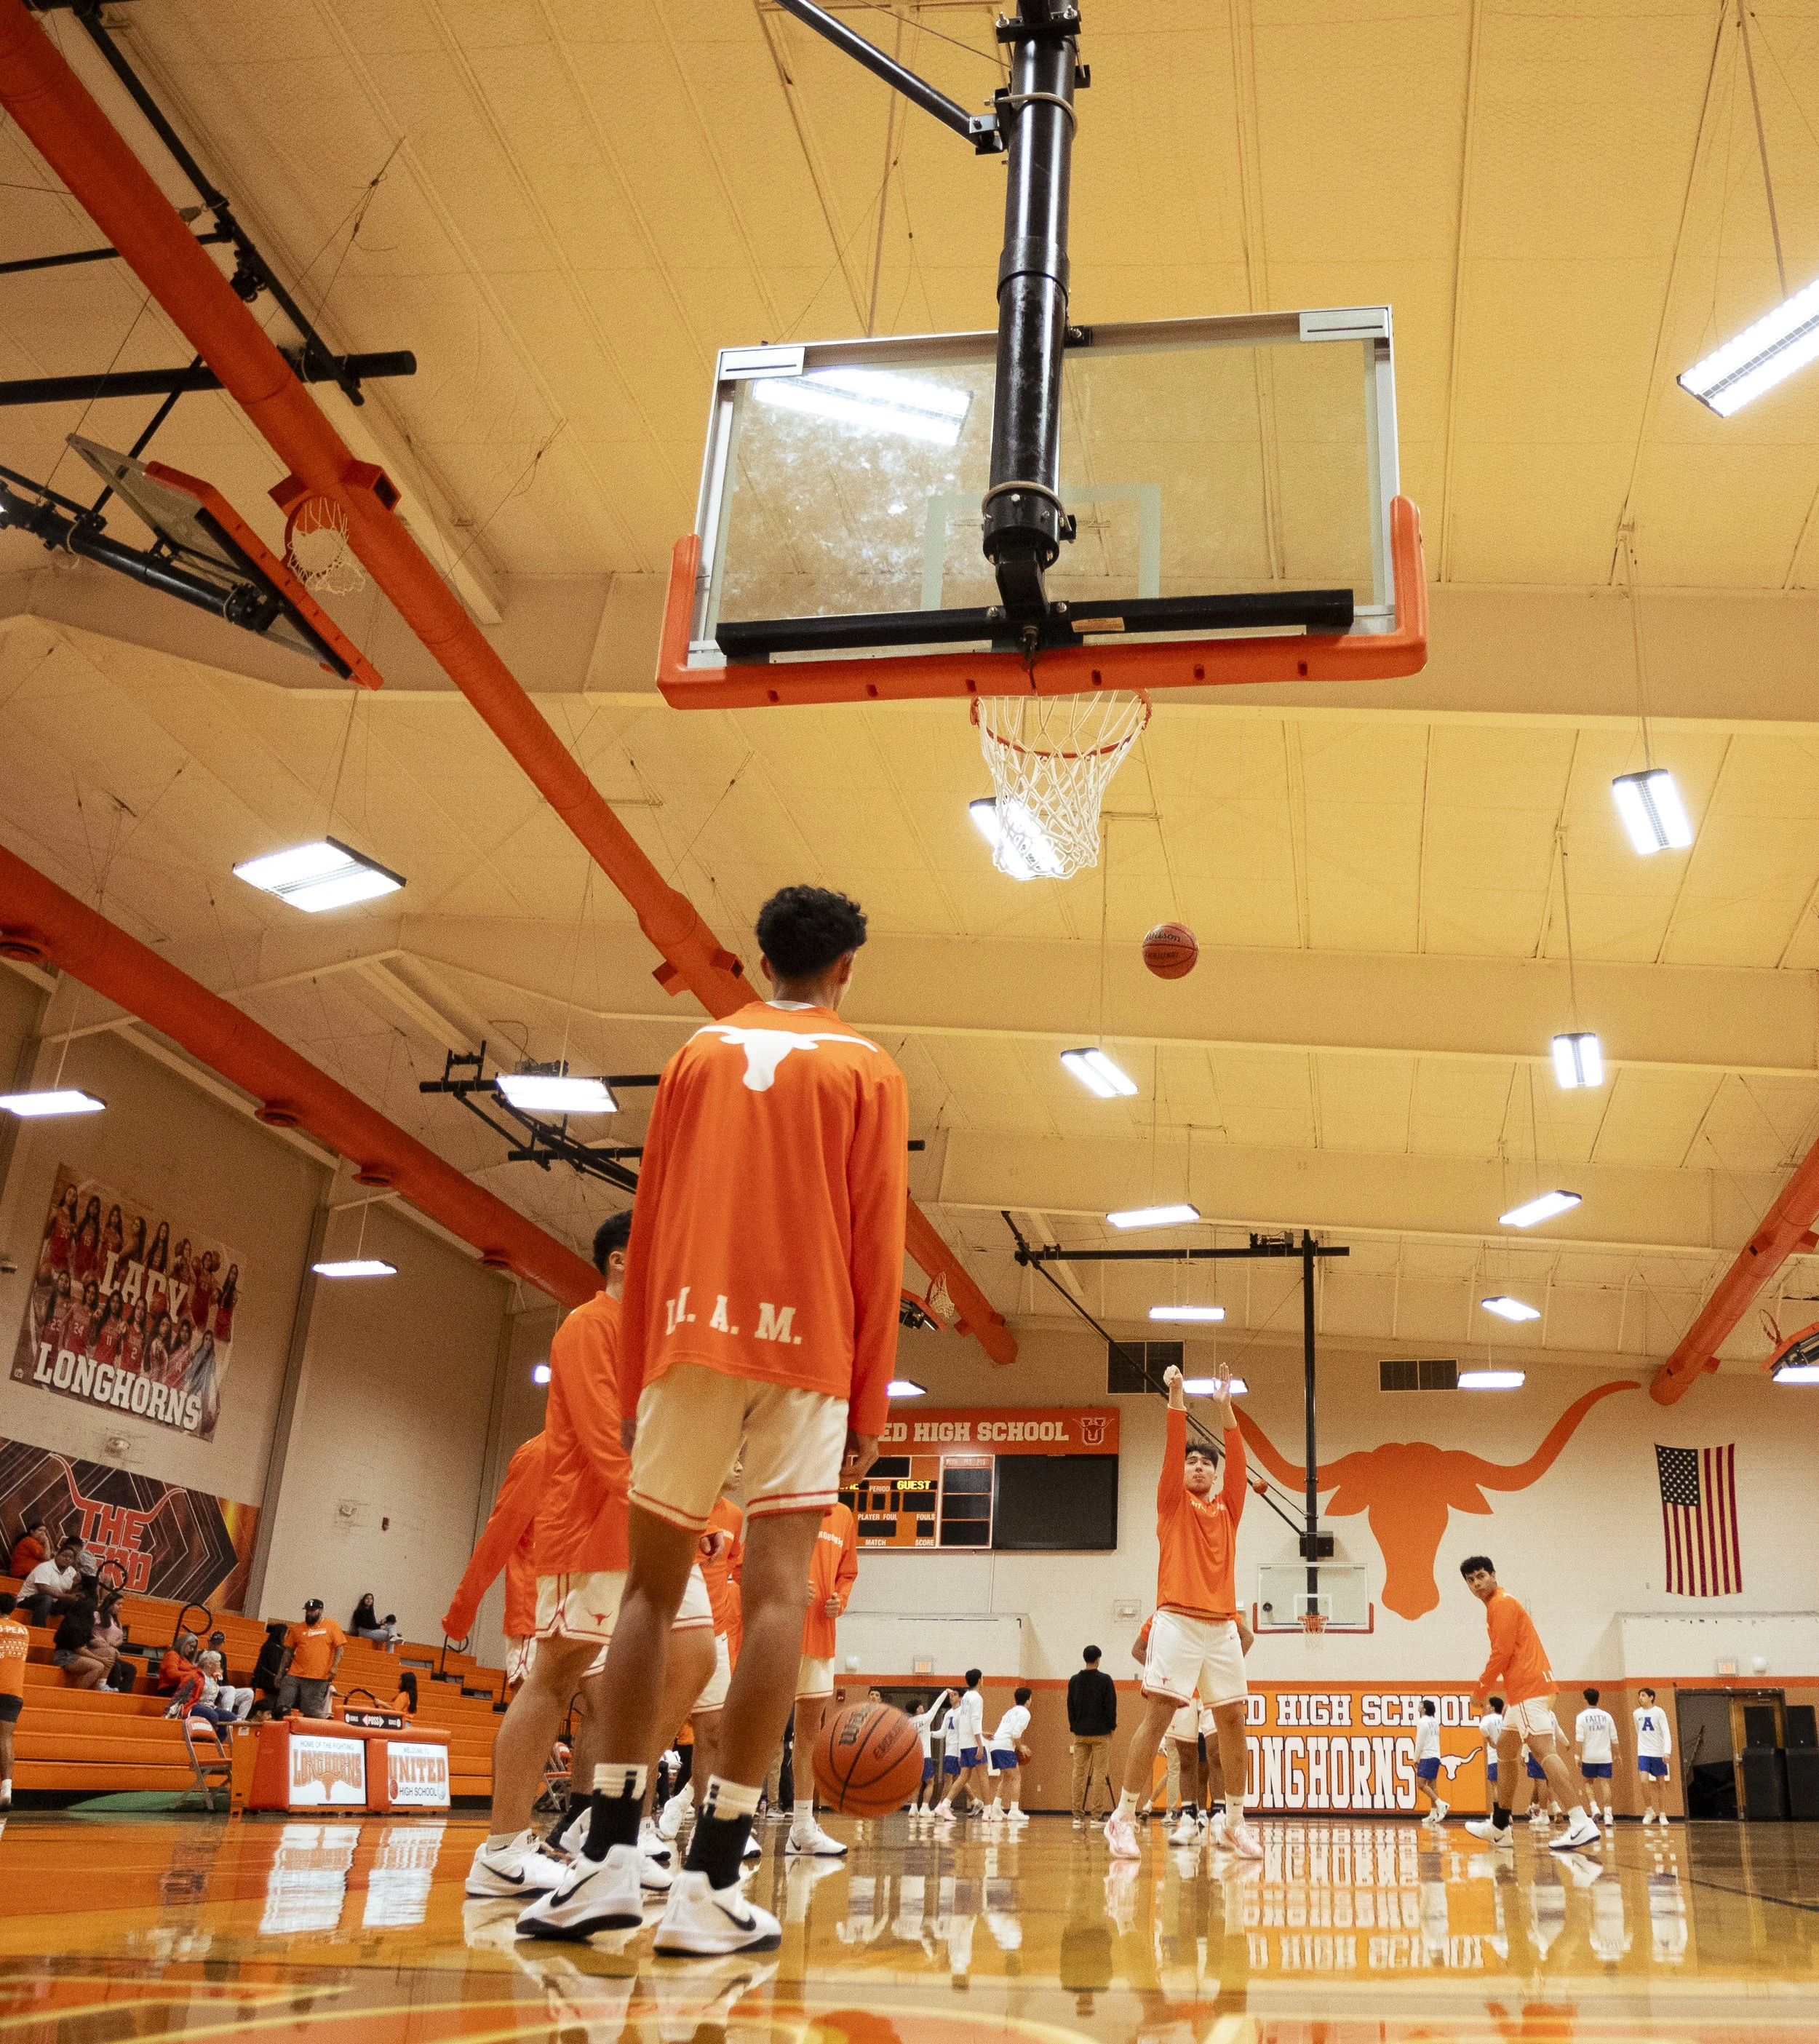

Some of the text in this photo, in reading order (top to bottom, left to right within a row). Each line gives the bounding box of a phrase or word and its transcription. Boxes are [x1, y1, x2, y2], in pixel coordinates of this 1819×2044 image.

[130, 1346, 138, 1360] 2
[33, 1341, 203, 1431] LONGHORNS
[877, 1421, 1070, 1442] ED HIGH SCHOOL
[896, 1480, 931, 1490] GUEST
[79, 1496, 150, 1551] THE
[83, 1540, 153, 1592] ERD
[1276, 1694, 1352, 1726] HIGH
[1361, 1694, 1481, 1727] SCHOOL
[1585, 1714, 1607, 1723] FAITH
[1641, 1717, 1655, 1731] A
[300, 1740, 314, 1748] HOME
[323, 1741, 332, 1749] THE
[292, 1749, 362, 1789] LONGHORNS
[388, 1754, 447, 1783] UNITED
[1243, 1736, 1418, 1810] ONGHORNS
[399, 1786, 437, 1797] HIGH SCHOOL
